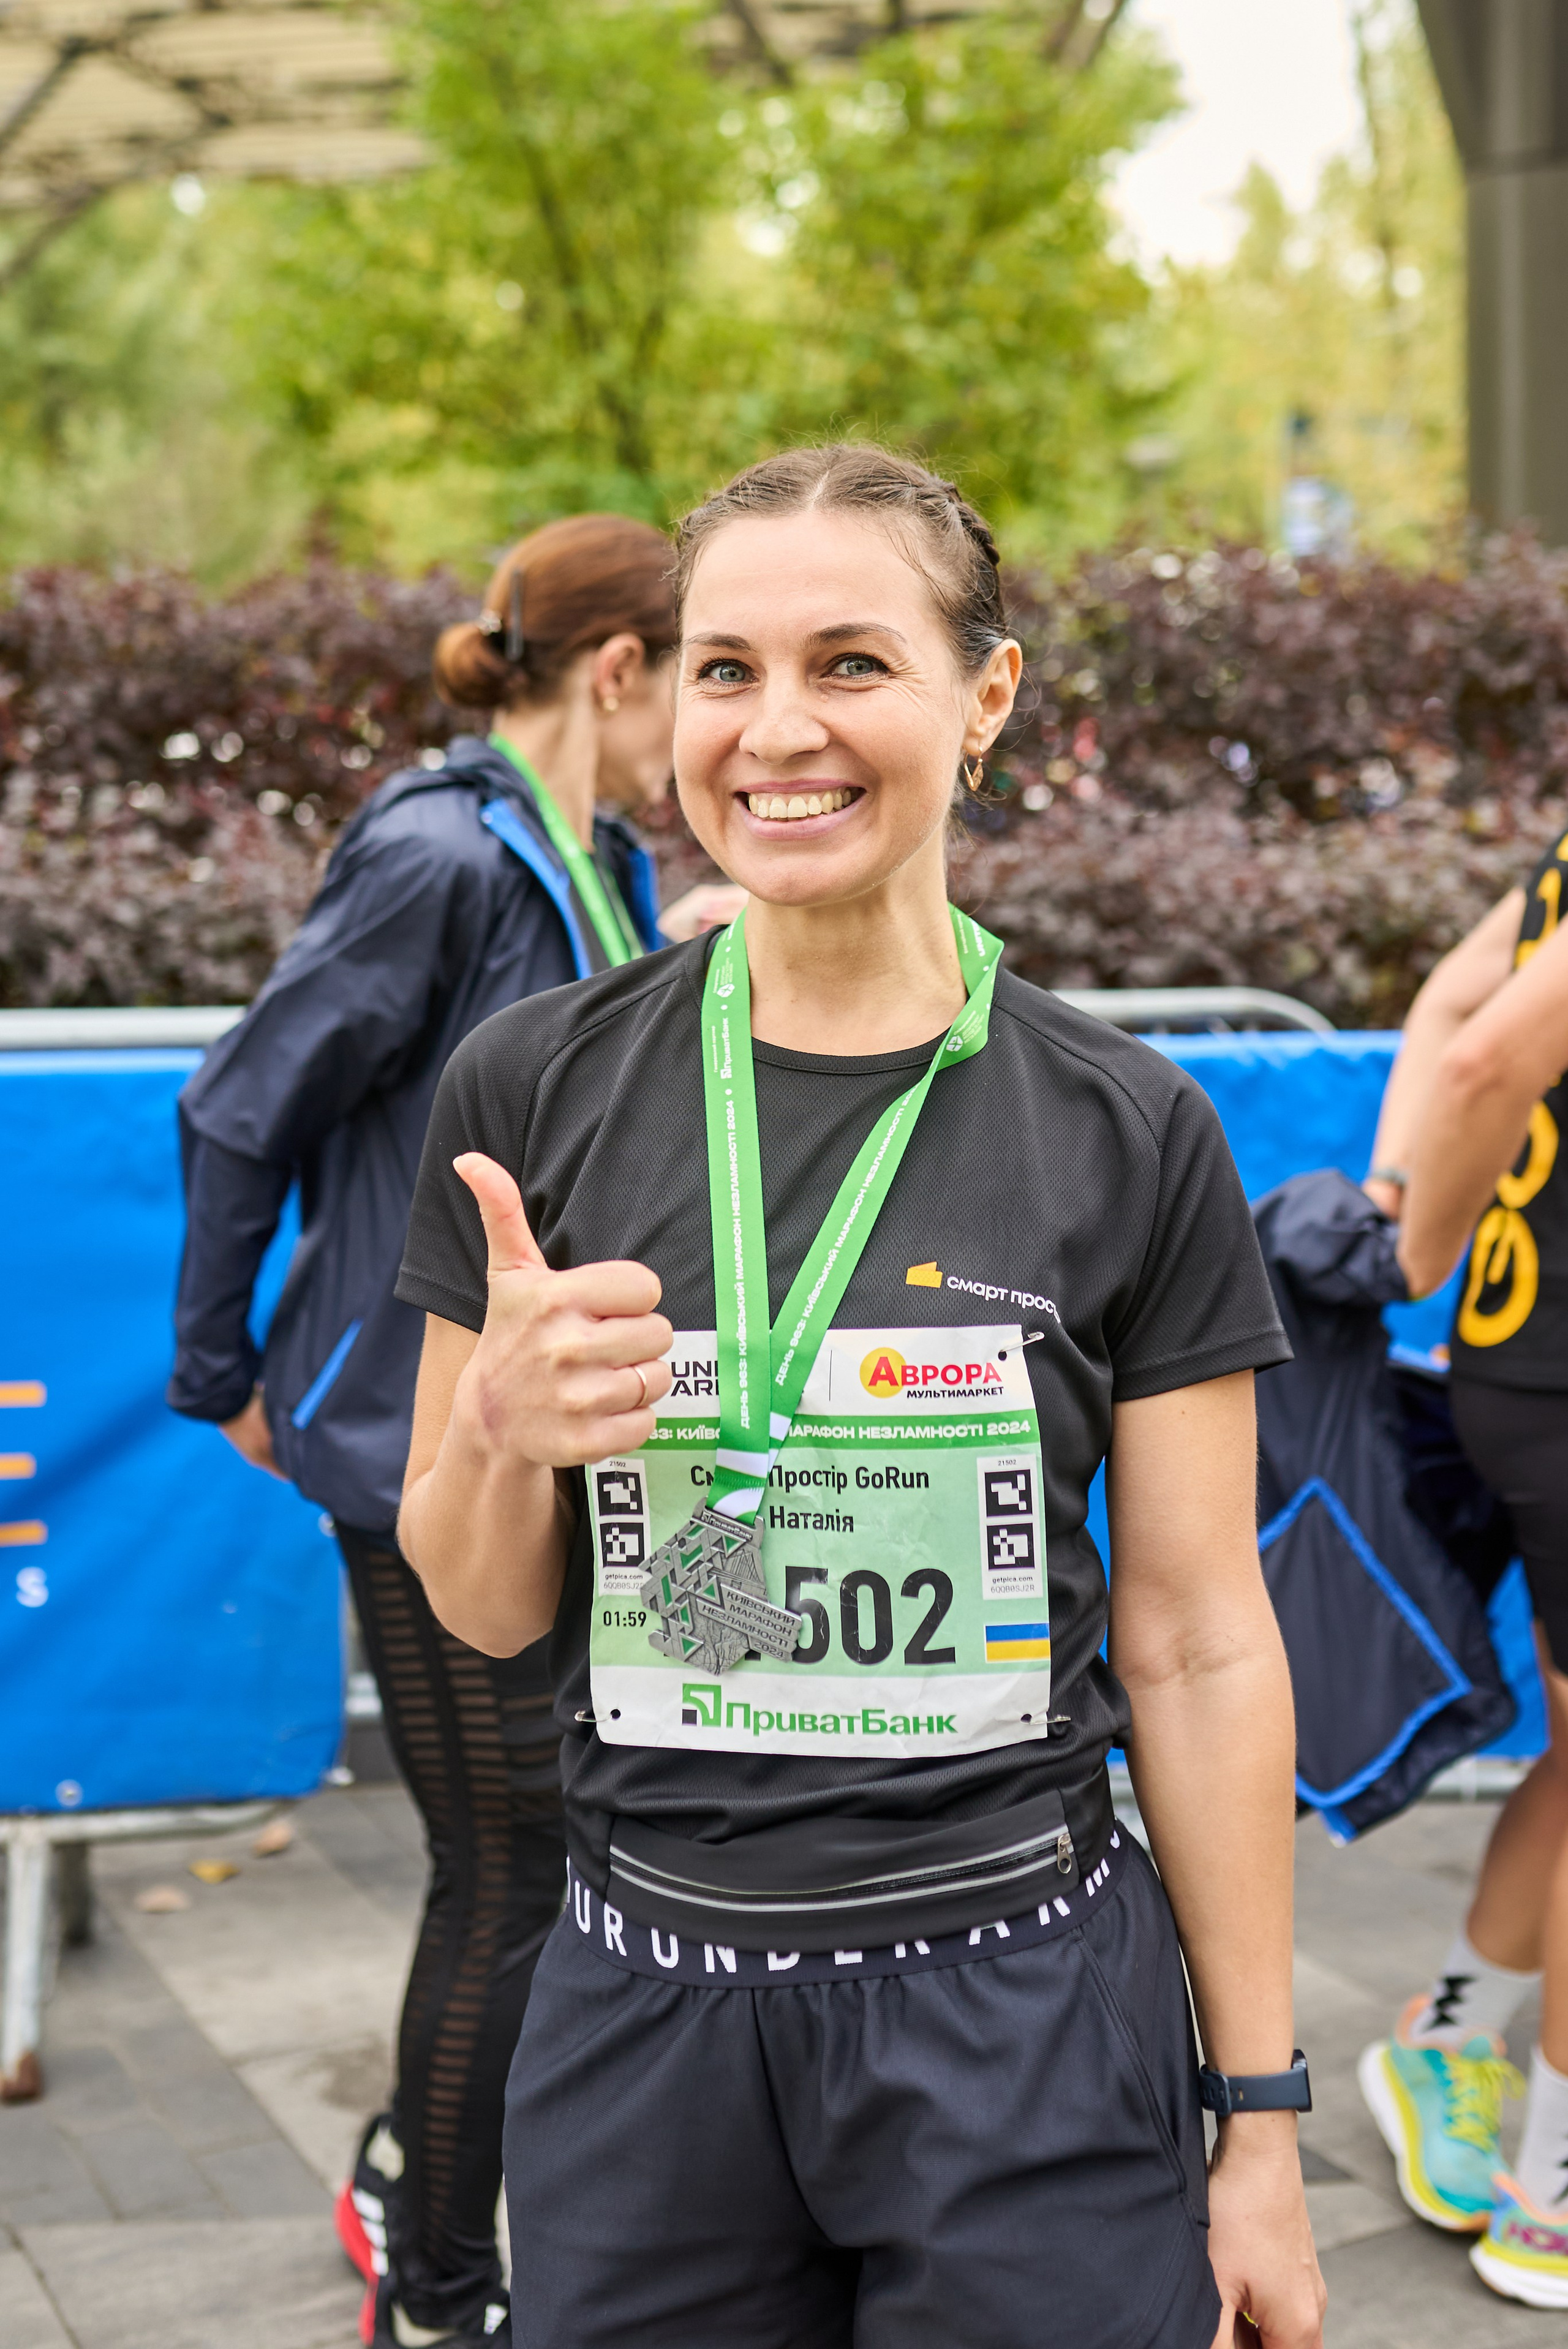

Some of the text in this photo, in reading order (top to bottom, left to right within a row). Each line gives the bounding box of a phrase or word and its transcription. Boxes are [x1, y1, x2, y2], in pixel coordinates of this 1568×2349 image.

[721, 1017, 733, 1069] ПриватБанк
[775, 1349, 795, 1386] ДЕНЬ
[789, 1318, 807, 1347] 963:
[802, 1248, 839, 1318] КИЇВСЬКИЙ
[834, 1188, 867, 1248] МАРАФОН
[862, 1107, 905, 1188] НЕЗЛАМНОСТІ
[726, 1100, 750, 1429] ДЕНЬ 963: КИЇВСЬКИЙ МАРАФОН НЕЗЛАМНОСТІ 2024
[947, 1276, 1061, 1324] смарт прос
[671, 1360, 718, 1378] UNI
[868, 1356, 1003, 1387] АВРОРА
[670, 1379, 720, 1397] AR
[906, 1386, 1005, 1400] МУЛЬТИМАРКЕТ
[648, 1428, 673, 1440] 63:
[859, 1422, 984, 1439] НЕЗЛАМНОСТІ
[986, 1420, 1031, 1436] 2024
[769, 1465, 930, 1494] Простір GoRun
[769, 1506, 854, 1533] Наталія
[992, 1576, 1033, 1585] getpica.com
[603, 1610, 647, 1627] 01:59
[702, 1605, 789, 1648] НЕЗЛАМНОСТІ
[729, 1604, 793, 1637] МАРАФОН
[744, 1565, 957, 1665] 502
[753, 1640, 785, 1659] 2024
[726, 1702, 959, 1737] ПриватБанк
